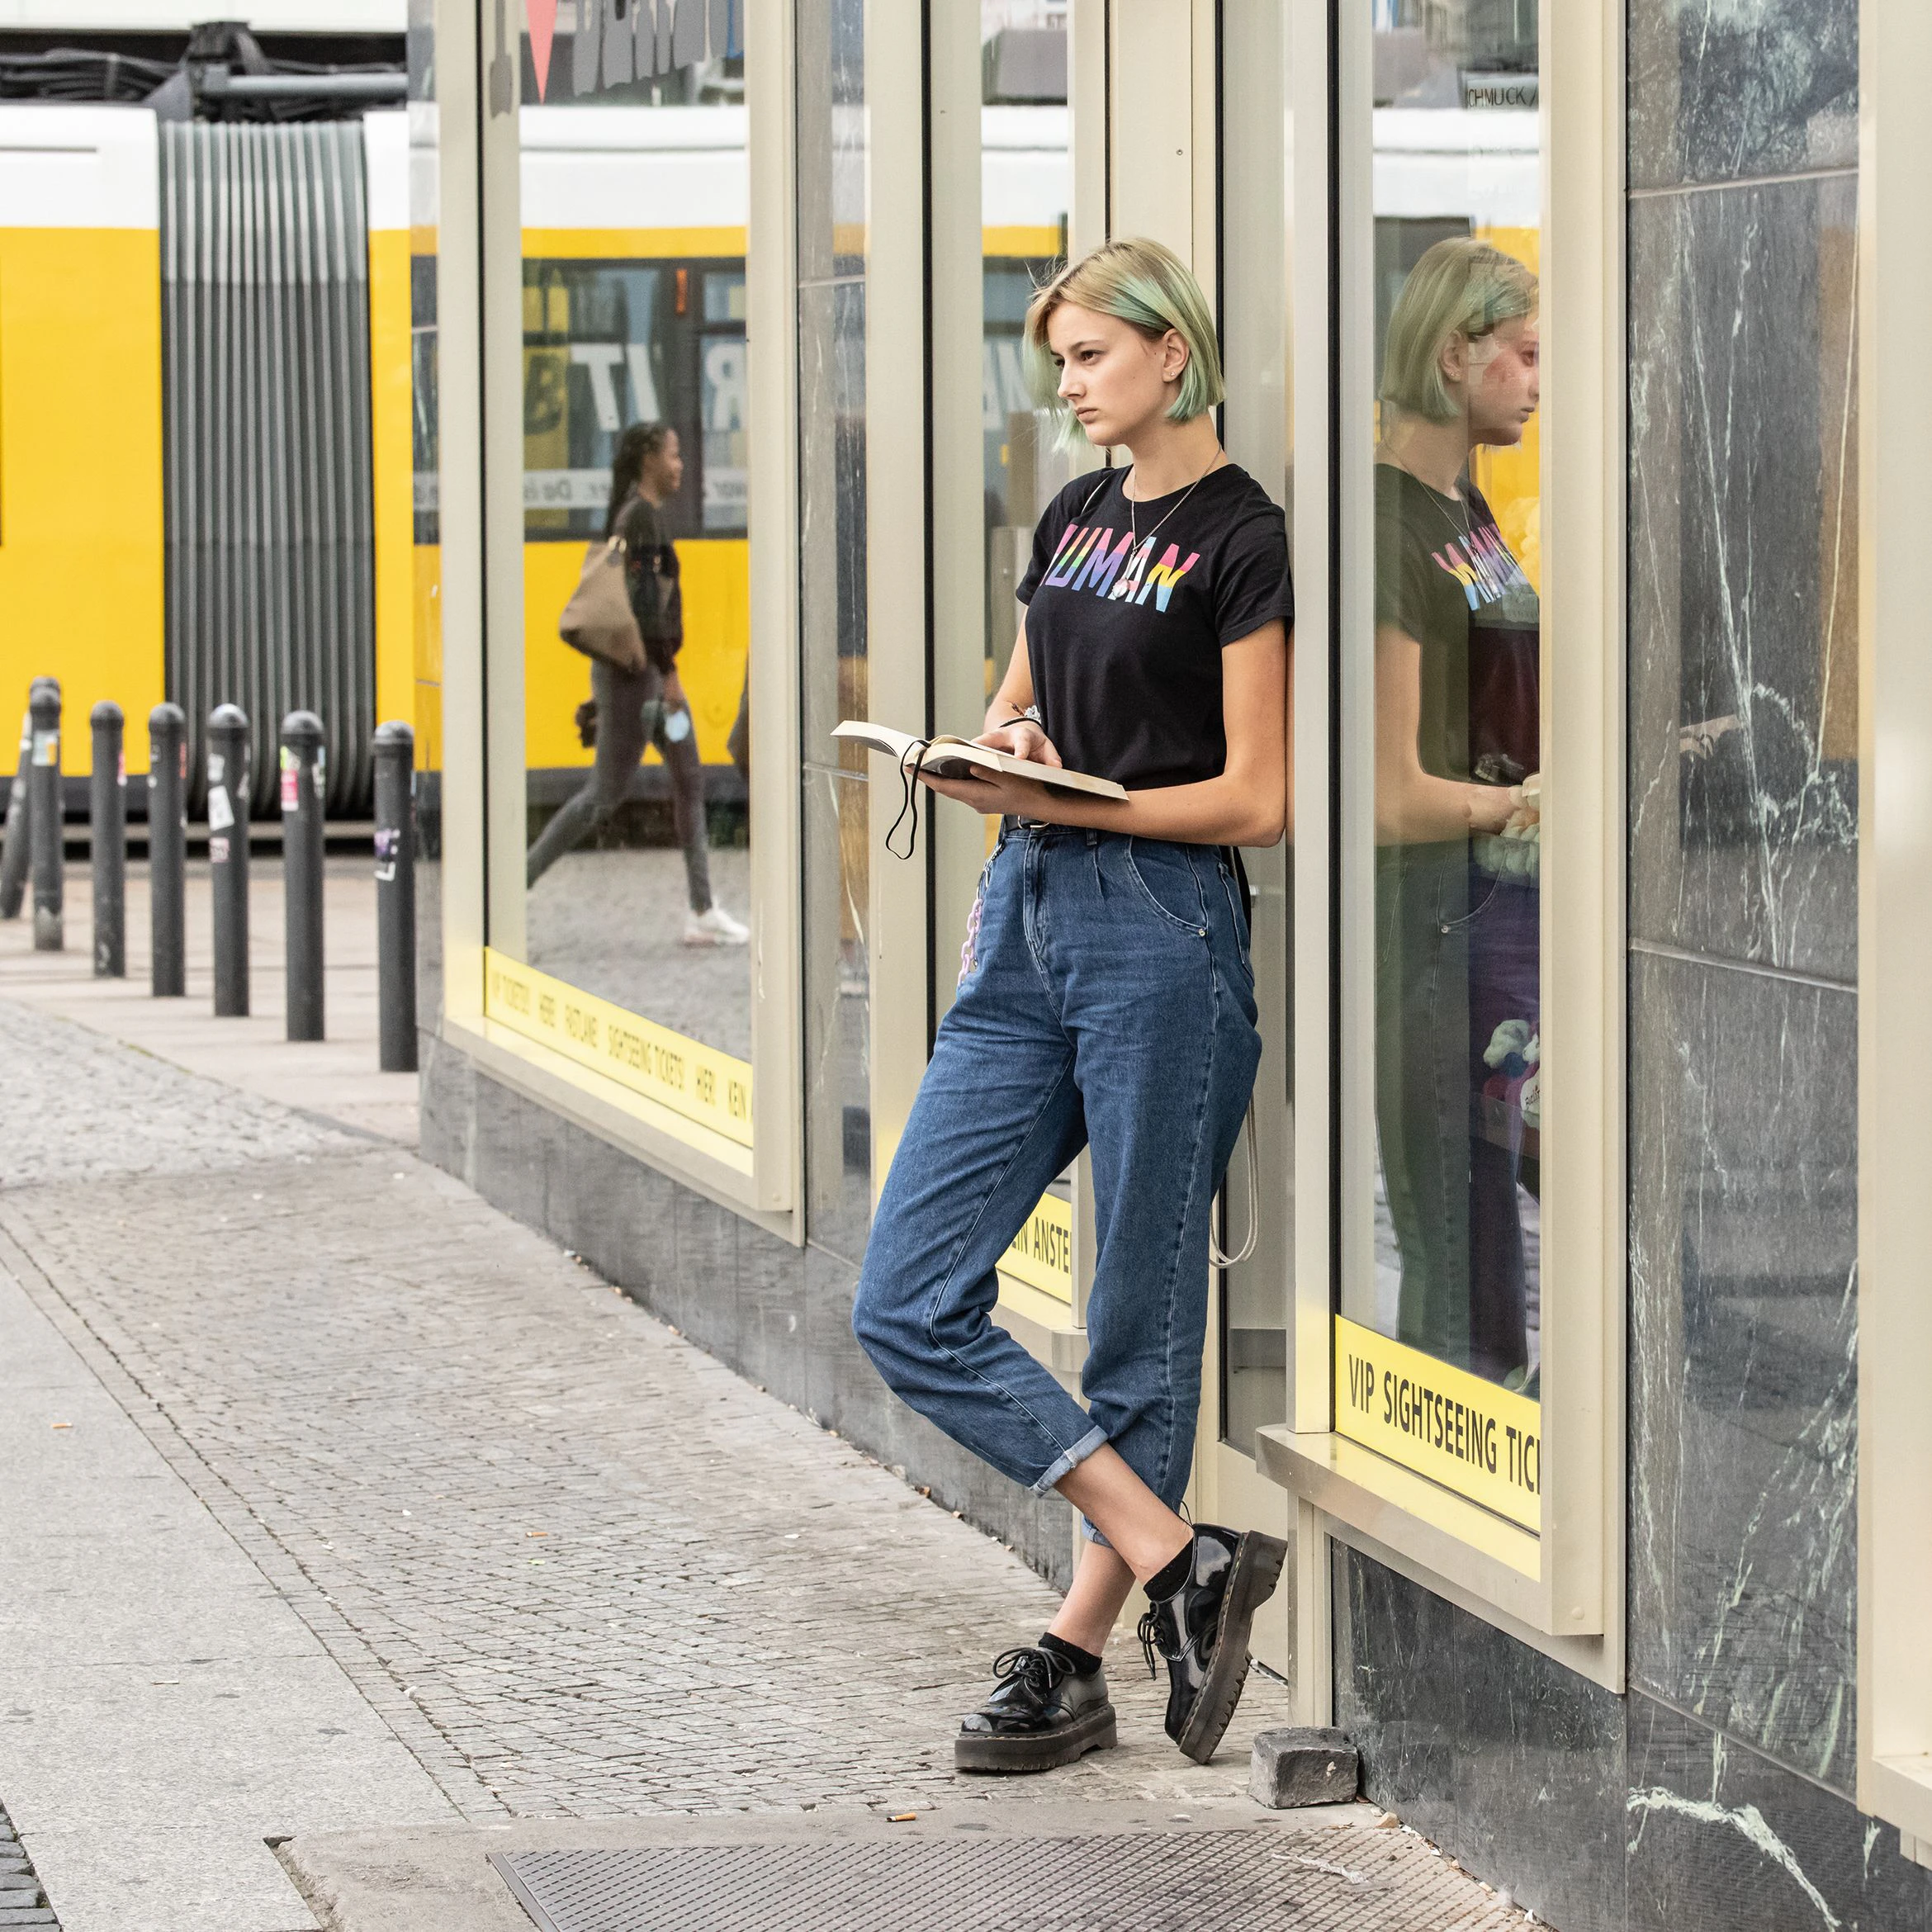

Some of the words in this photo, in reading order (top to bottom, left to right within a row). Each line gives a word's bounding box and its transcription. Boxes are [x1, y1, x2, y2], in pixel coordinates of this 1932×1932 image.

[1466, 85, 1527, 107] CHMUCK
[1033, 1216, 1073, 1276] ANSTE
[1348, 1353, 1376, 1415] VIP
[1383, 1370, 1498, 1475] SIGHTSEEING
